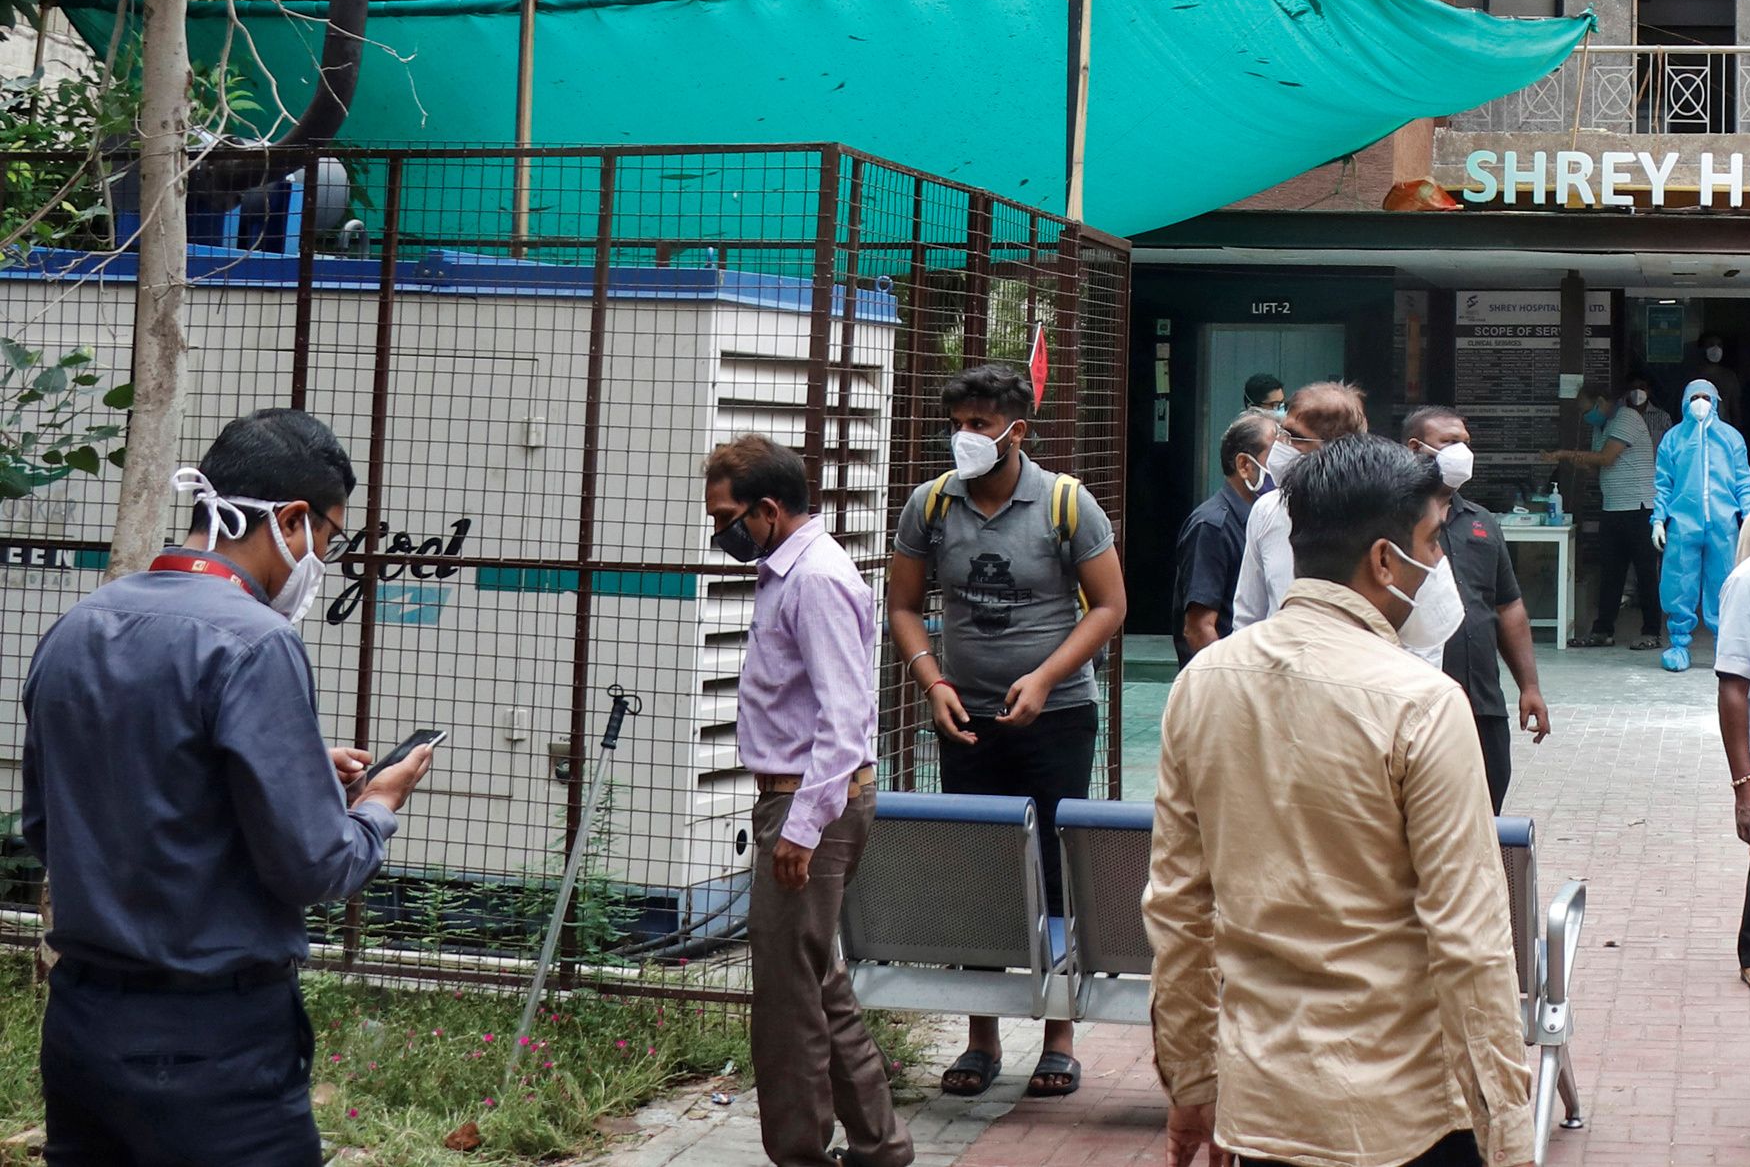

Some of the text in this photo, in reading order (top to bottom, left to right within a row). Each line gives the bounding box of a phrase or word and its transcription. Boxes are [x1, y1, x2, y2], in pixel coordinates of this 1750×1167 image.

[1462, 150, 1679, 208] SHREY
[1252, 302, 1291, 314] LIFT-2
[1488, 304, 1517, 313] SHREY
[1588, 304, 1607, 313] LTD.
[1474, 326, 1514, 337] SCOPE
[1516, 326, 1533, 337] OF
[1467, 339, 1522, 347] CLINICAL SERVICES
